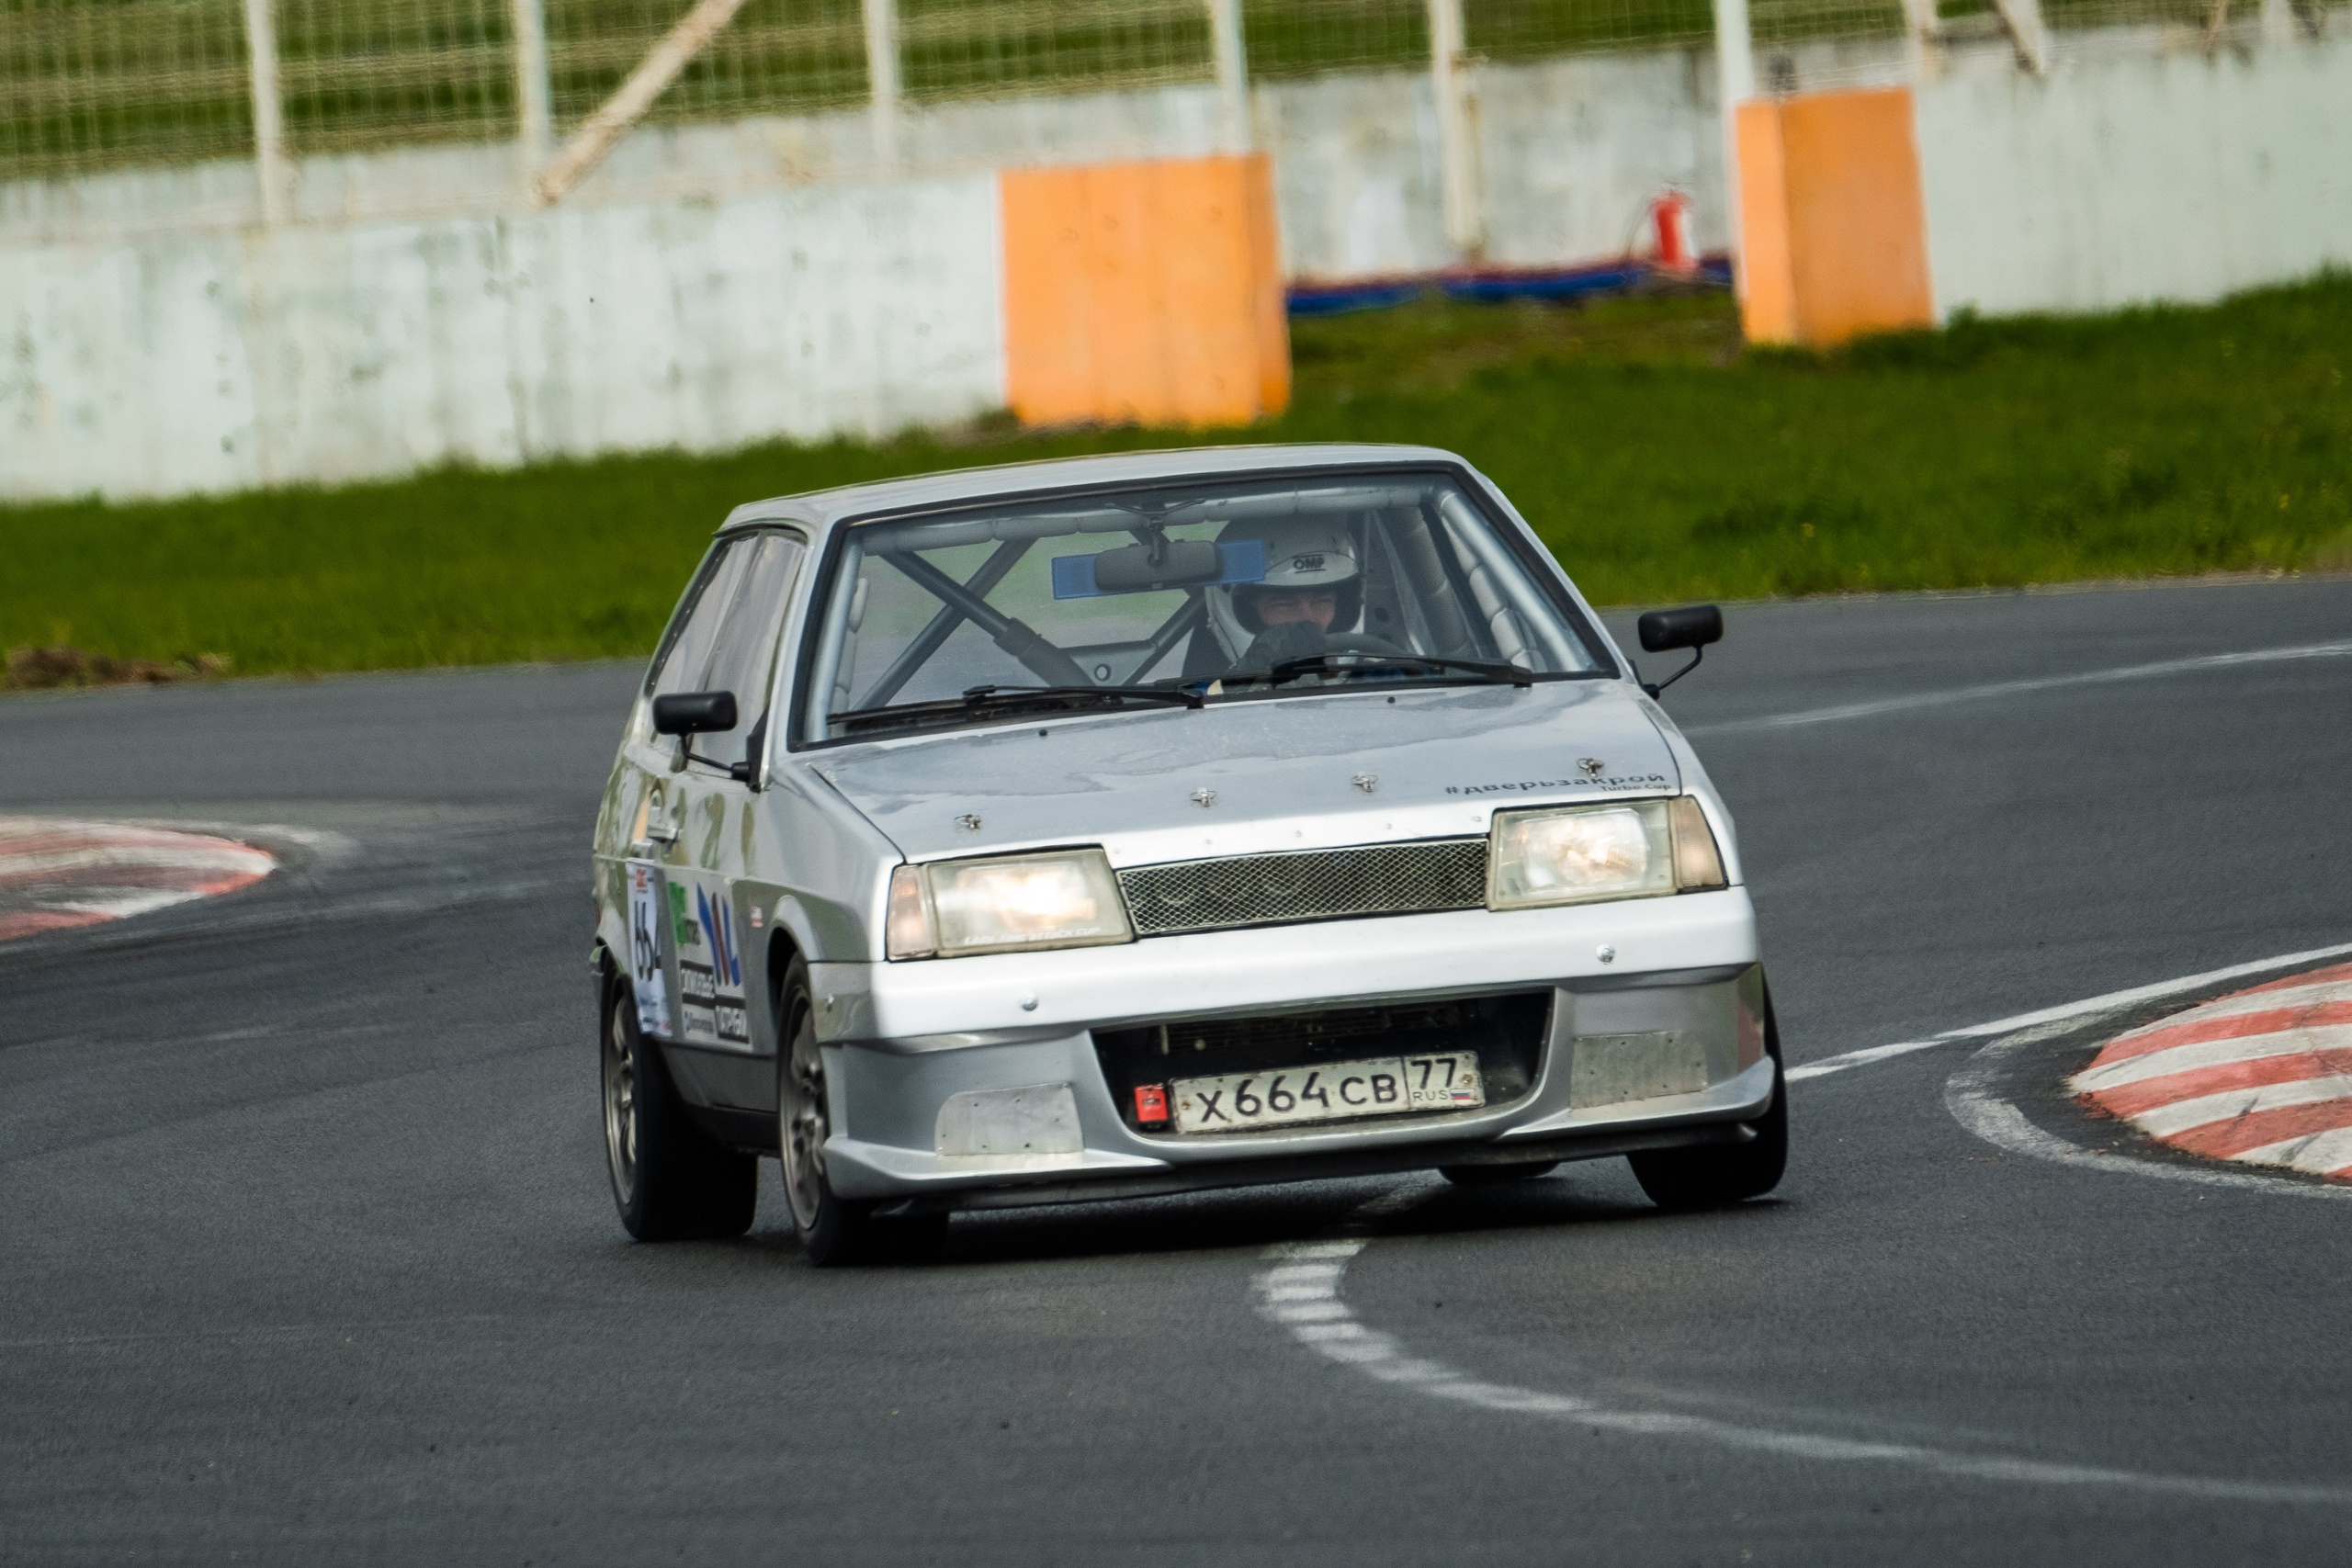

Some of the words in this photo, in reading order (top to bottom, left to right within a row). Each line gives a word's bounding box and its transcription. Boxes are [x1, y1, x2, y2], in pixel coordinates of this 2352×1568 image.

[1294, 557, 1325, 570] OMP
[1445, 773, 1665, 795] #дверьзакрой
[1410, 1057, 1456, 1090] 77
[1412, 1089, 1449, 1101] RUS
